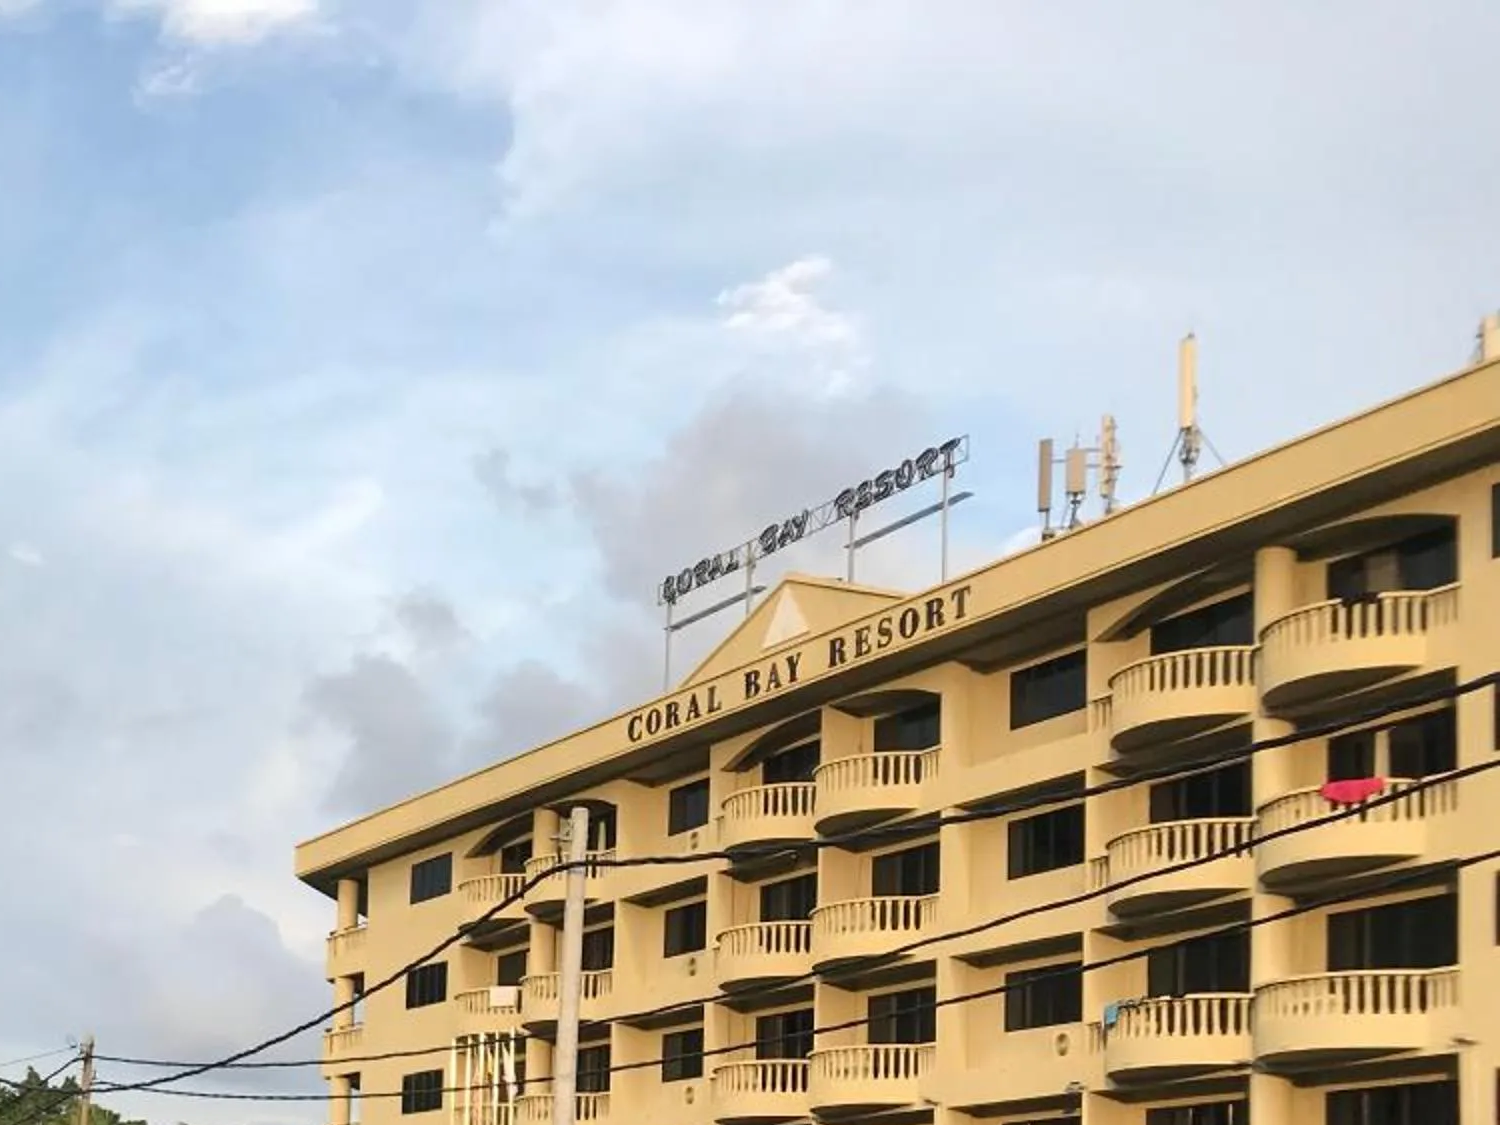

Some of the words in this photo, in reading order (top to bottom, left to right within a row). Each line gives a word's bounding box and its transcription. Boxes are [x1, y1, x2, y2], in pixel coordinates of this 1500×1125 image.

[662, 548, 740, 605] CORAL
[758, 509, 811, 555] BAY
[835, 437, 961, 520] RESORT
[626, 685, 723, 743] CORAL
[743, 651, 803, 701] BAY
[827, 585, 973, 669] RESORT
